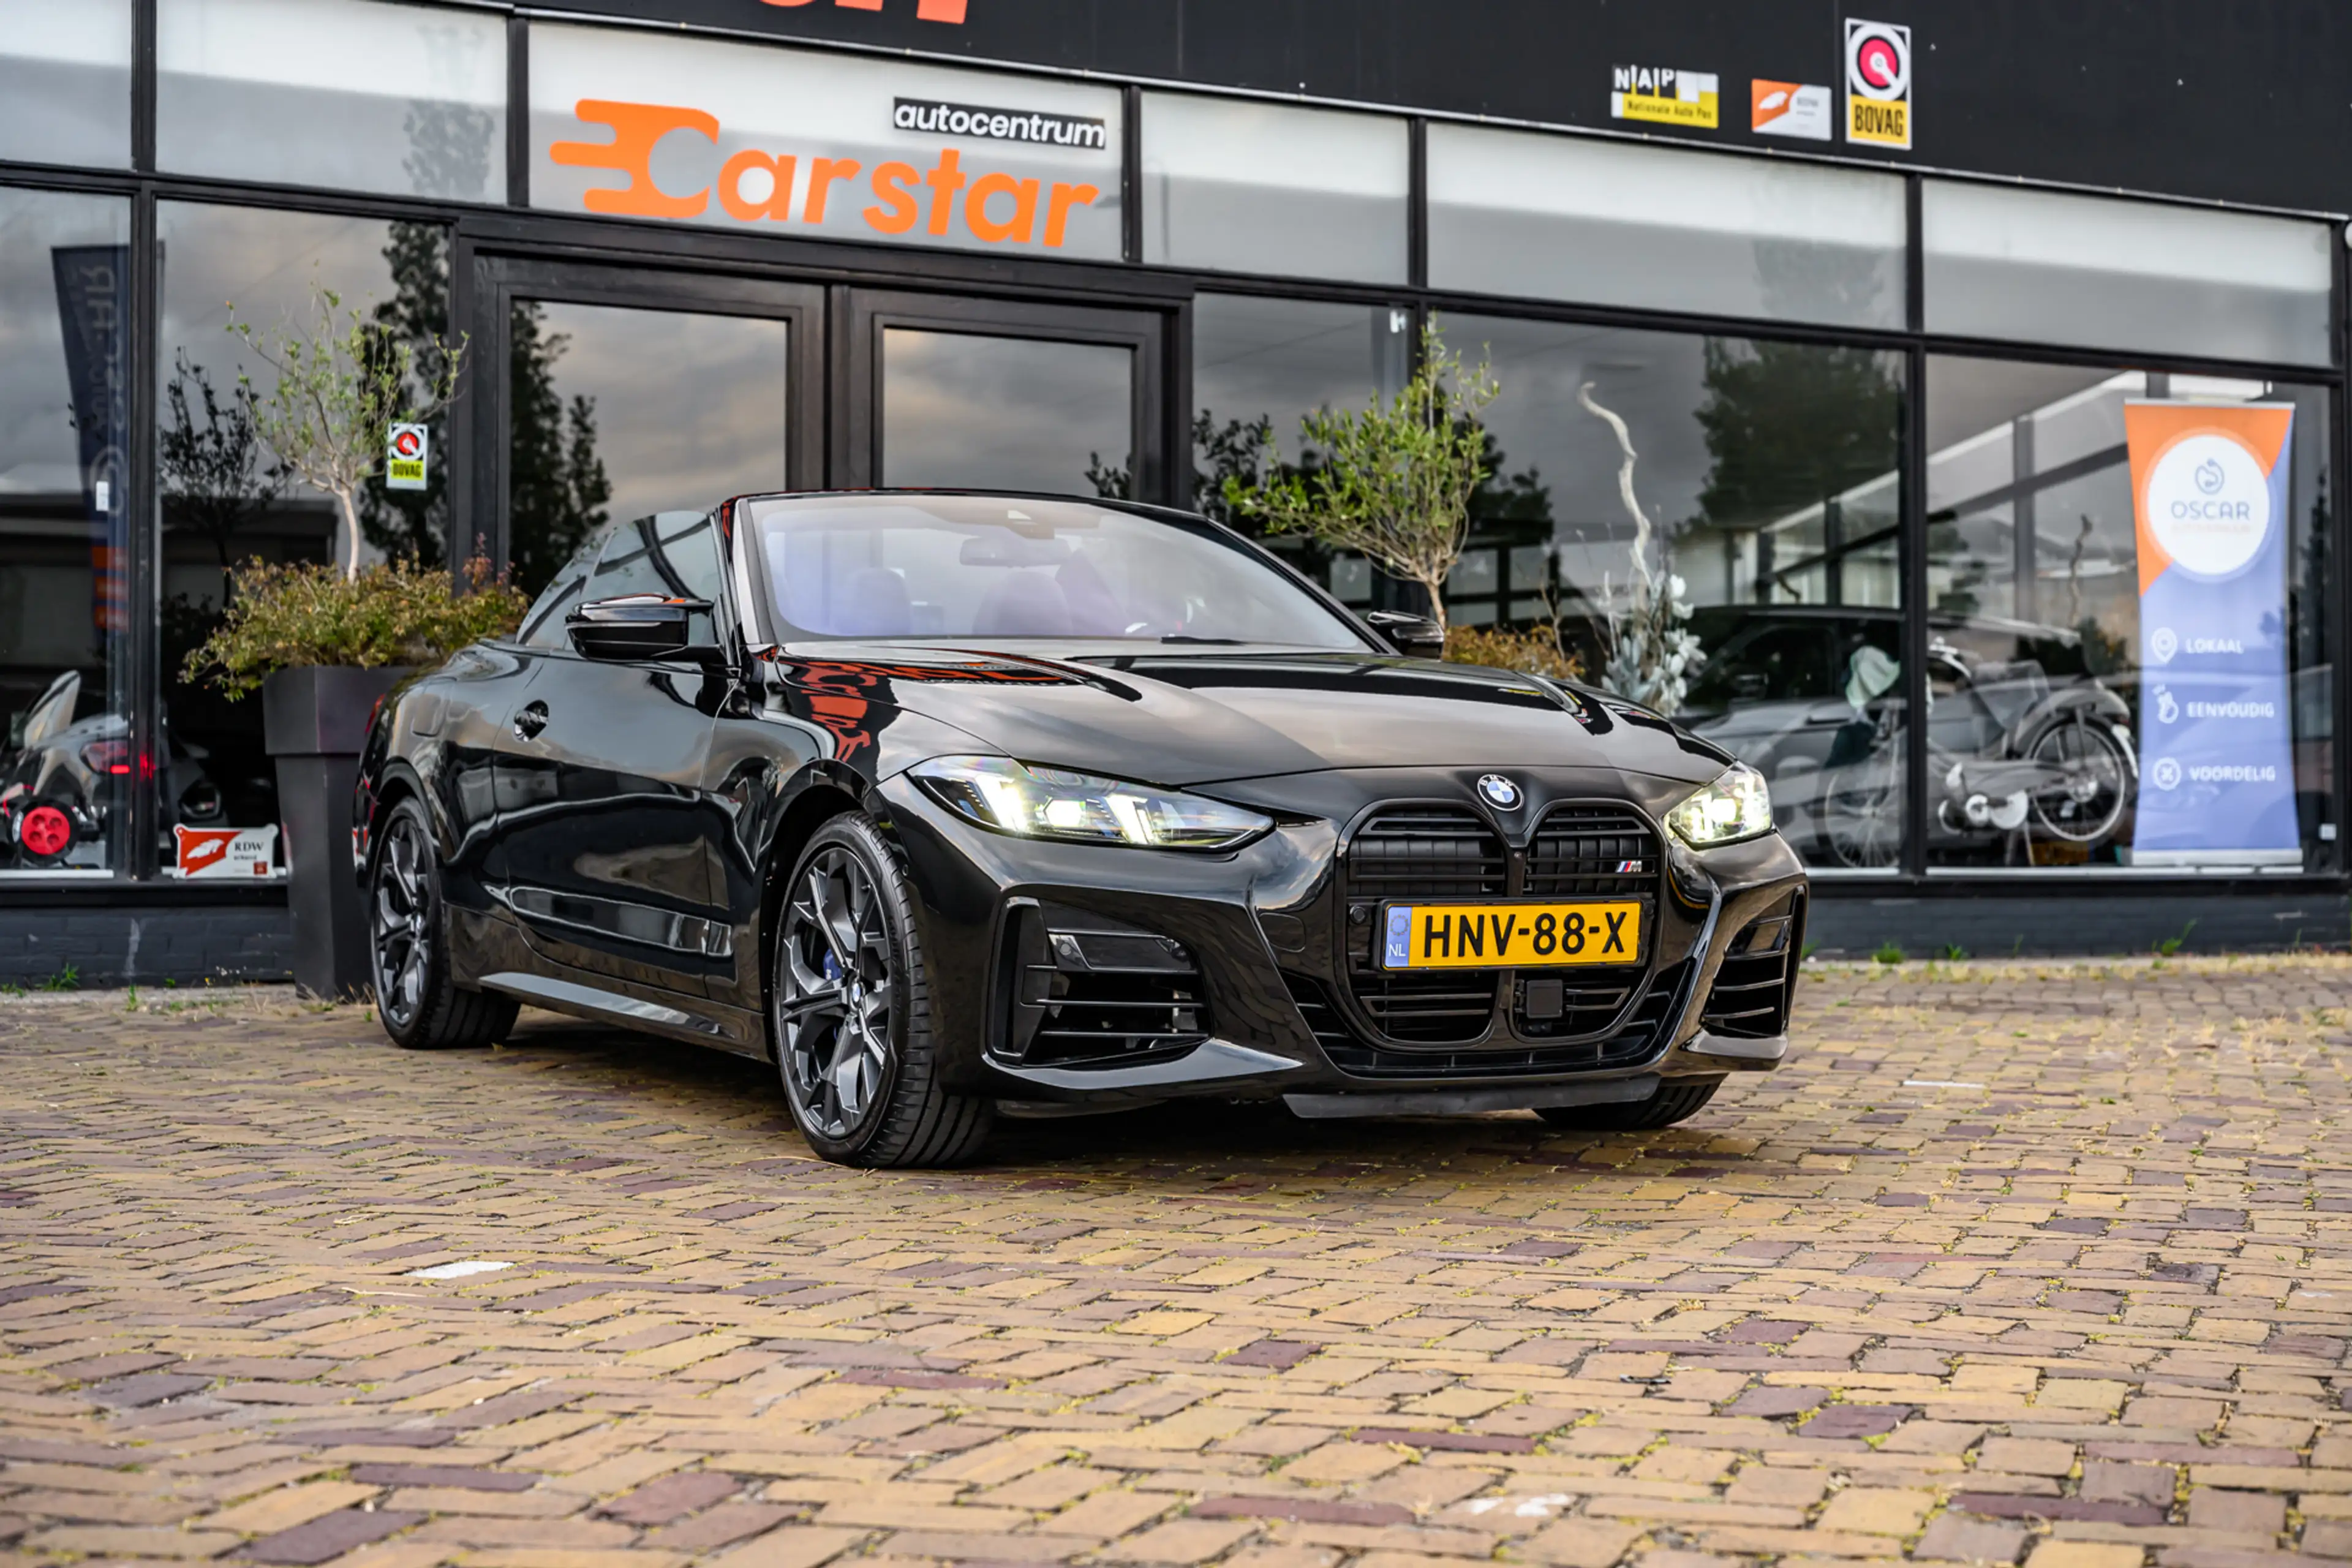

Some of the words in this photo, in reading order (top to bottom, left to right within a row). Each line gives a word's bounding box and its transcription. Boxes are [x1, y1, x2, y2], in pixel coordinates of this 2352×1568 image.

[895, 103, 1105, 147] autocentrum
[1855, 104, 1904, 137] BOVAG
[550, 98, 1099, 248] Carstar
[2171, 500, 2250, 521] OSCAR
[2185, 638, 2244, 654] LOKAAL
[2187, 701, 2275, 718] EENVOUDIG
[2189, 765, 2276, 782] VOORDELIG
[235, 842, 263, 851] RDW
[1423, 911, 1627, 958] HNV-88-X
[1389, 943, 1406, 957] NL
